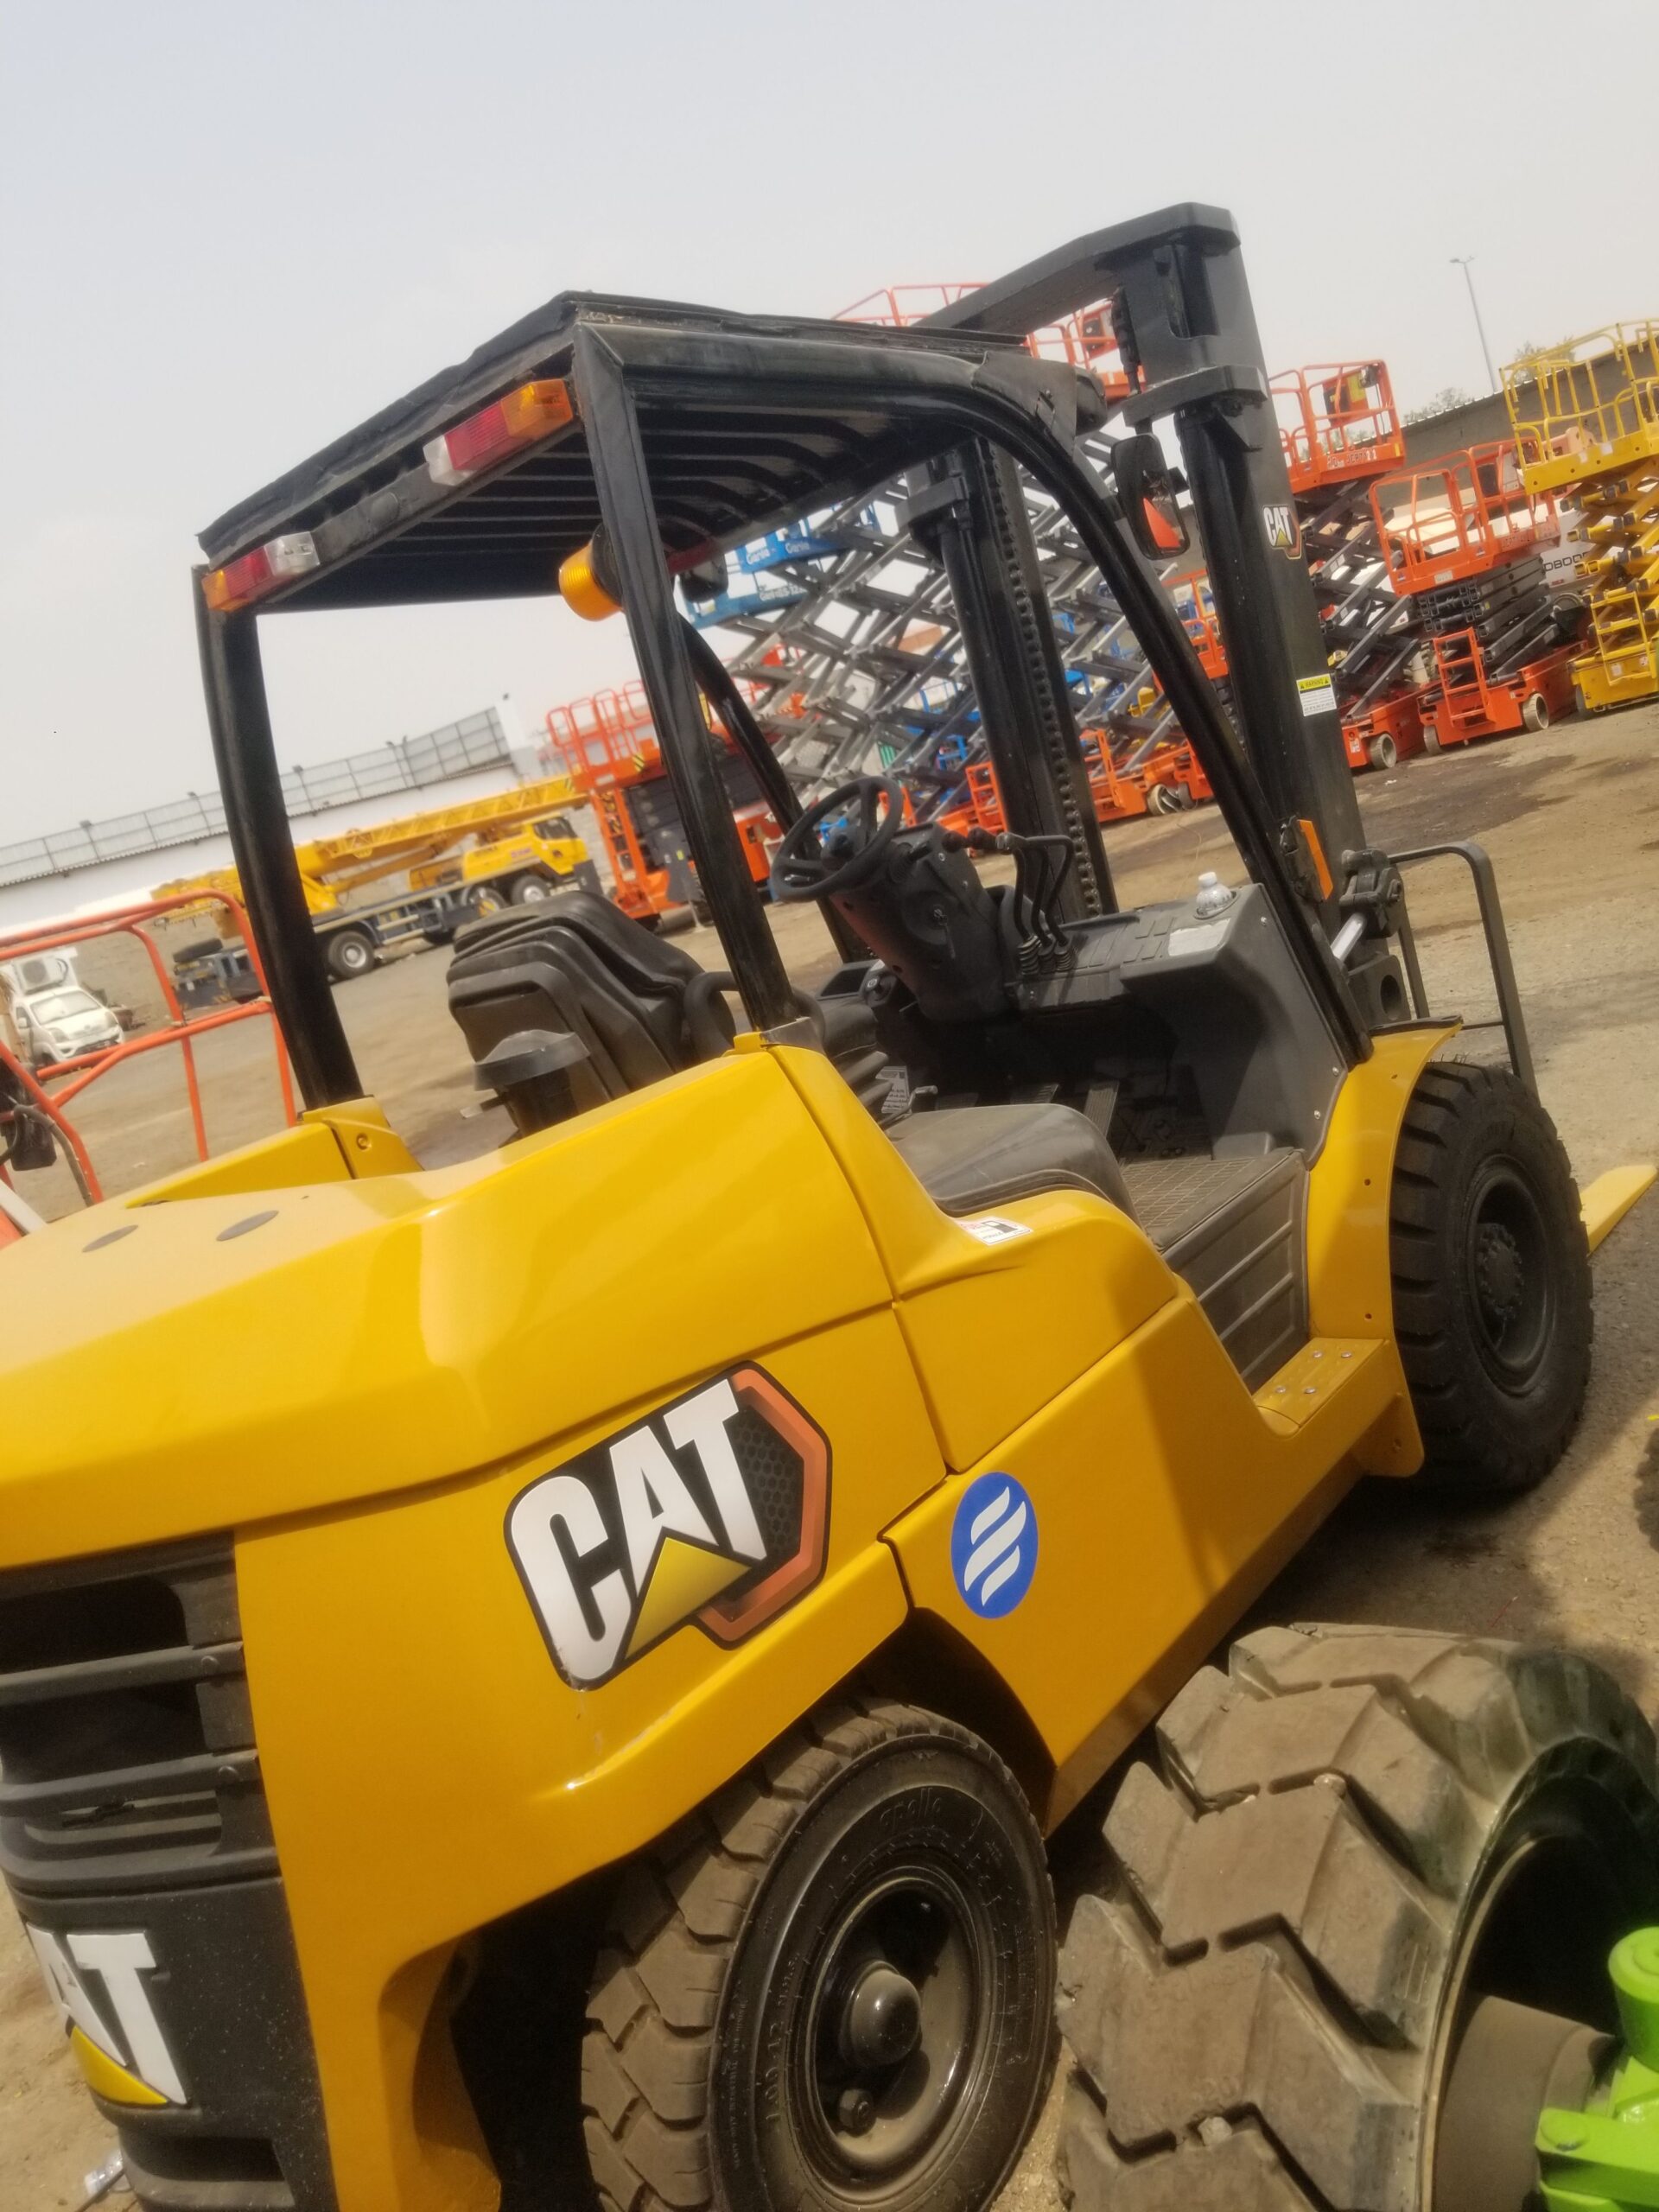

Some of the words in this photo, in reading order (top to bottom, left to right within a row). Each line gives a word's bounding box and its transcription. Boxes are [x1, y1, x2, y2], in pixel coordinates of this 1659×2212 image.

[1263, 506, 1294, 546] CAT
[511, 1378, 767, 1681] CAT
[26, 1919, 188, 2106] AT
